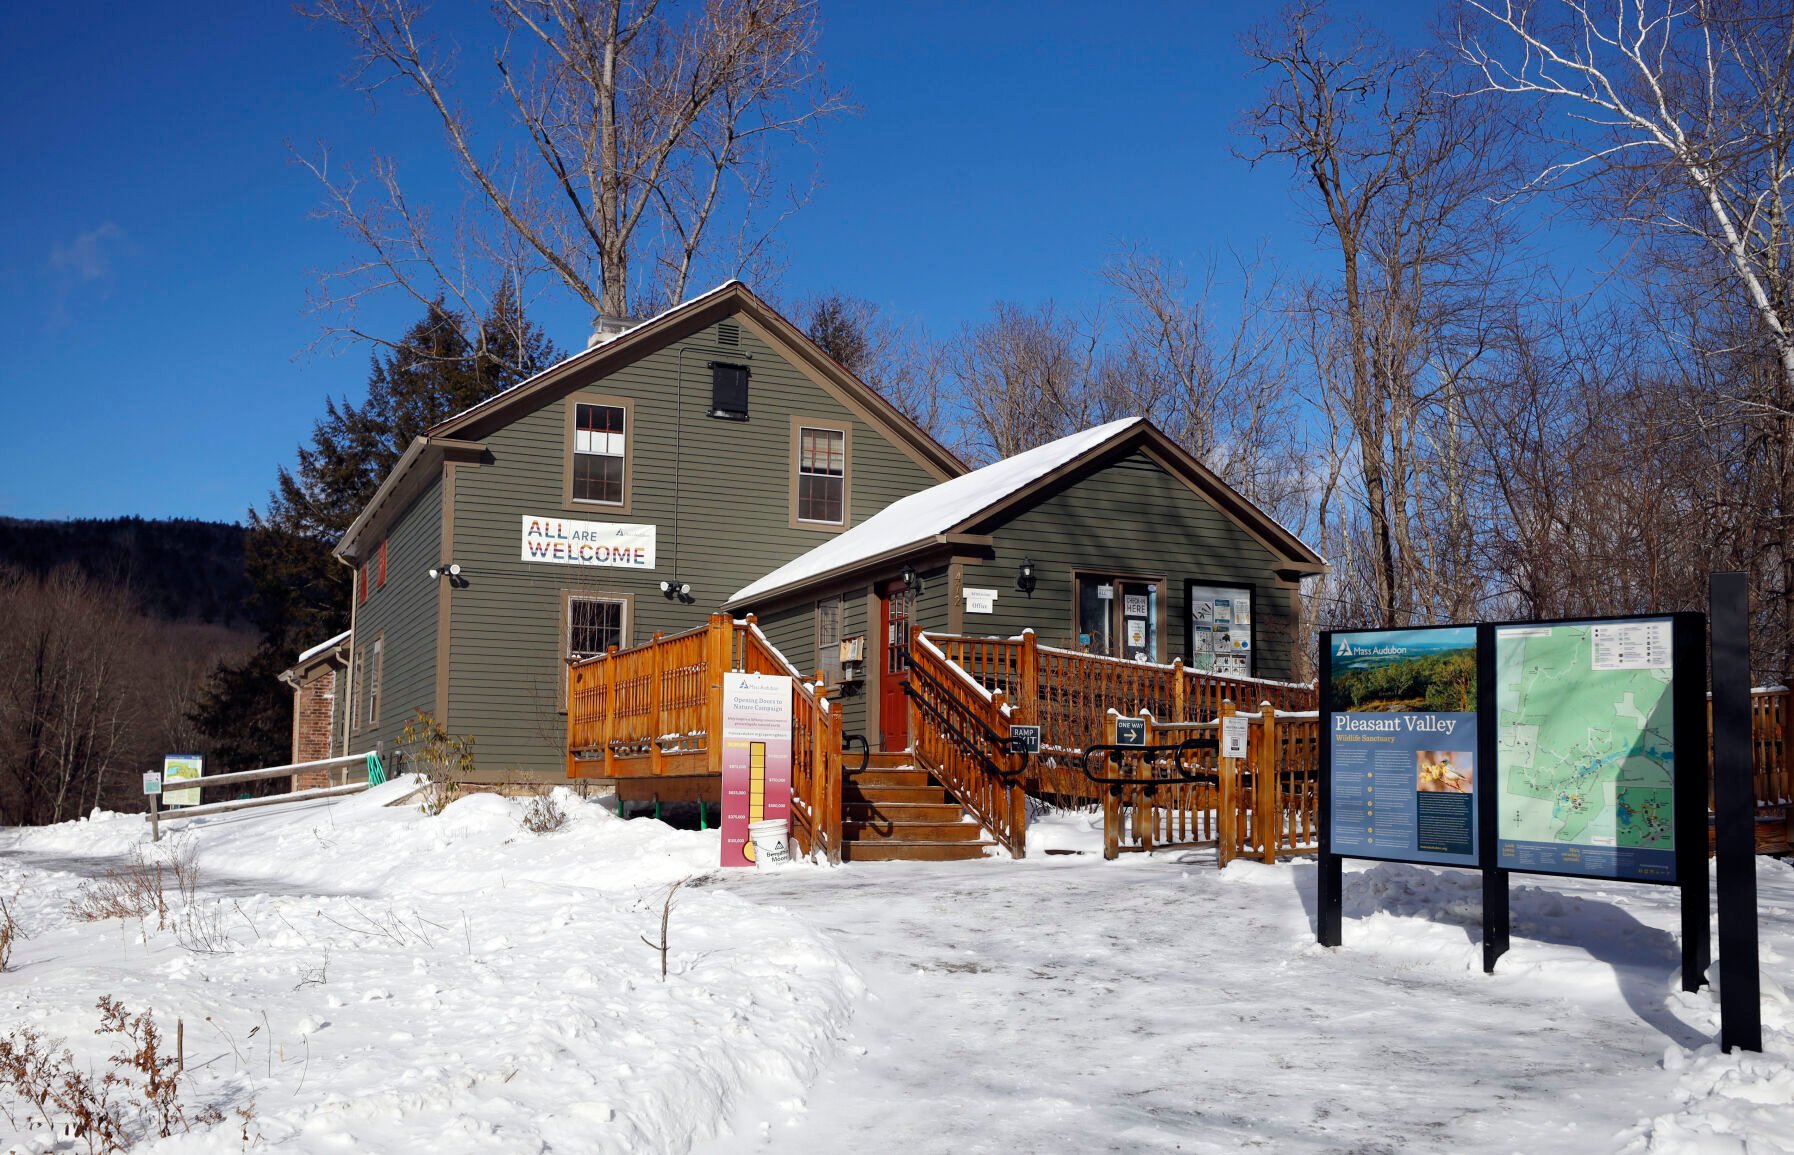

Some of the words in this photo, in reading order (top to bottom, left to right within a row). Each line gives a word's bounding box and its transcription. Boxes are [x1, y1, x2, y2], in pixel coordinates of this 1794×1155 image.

[528, 520, 567, 539] ALL
[572, 530, 597, 541] ARE
[528, 540, 645, 564] WELCOME
[1127, 604, 1145, 613] HERE
[1353, 646, 1371, 656] Mass
[1373, 645, 1406, 654] Audubon
[754, 704, 783, 713] Campaign
[1335, 716, 1401, 731] Pleasant
[1403, 716, 1456, 735] Valley
[1014, 728, 1034, 736] RAMP
